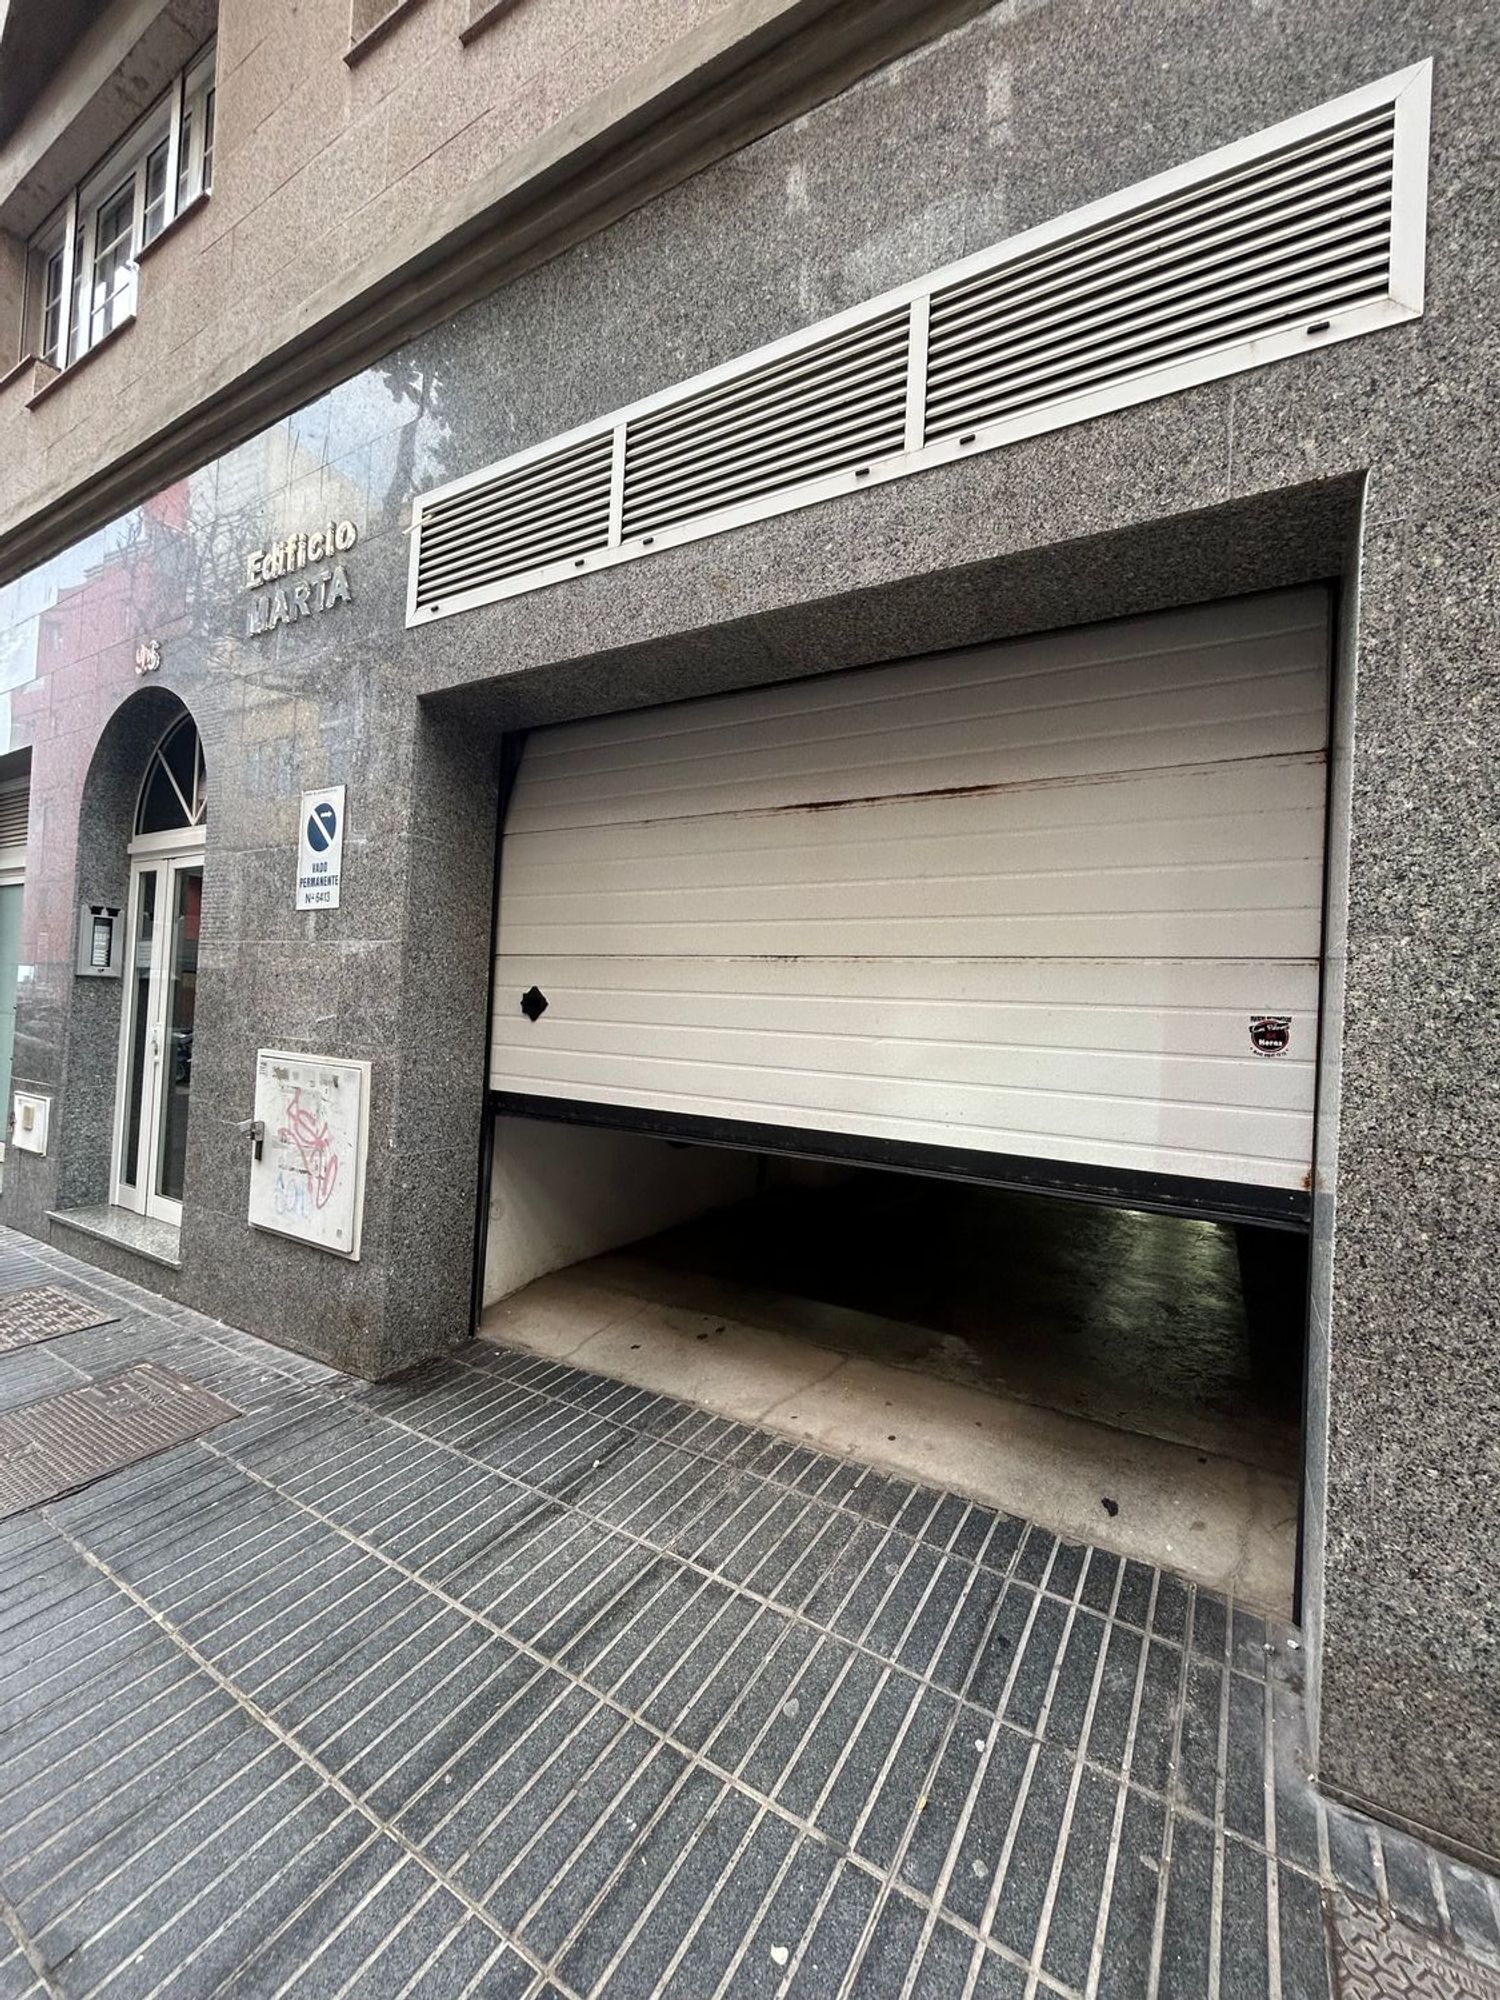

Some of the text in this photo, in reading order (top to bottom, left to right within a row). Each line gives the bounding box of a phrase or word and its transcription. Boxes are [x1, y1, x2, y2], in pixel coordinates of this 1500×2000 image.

[245, 520, 358, 591] Edificio
[248, 565, 352, 638] MARTA
[300, 874, 339, 888] PERMANENTE
